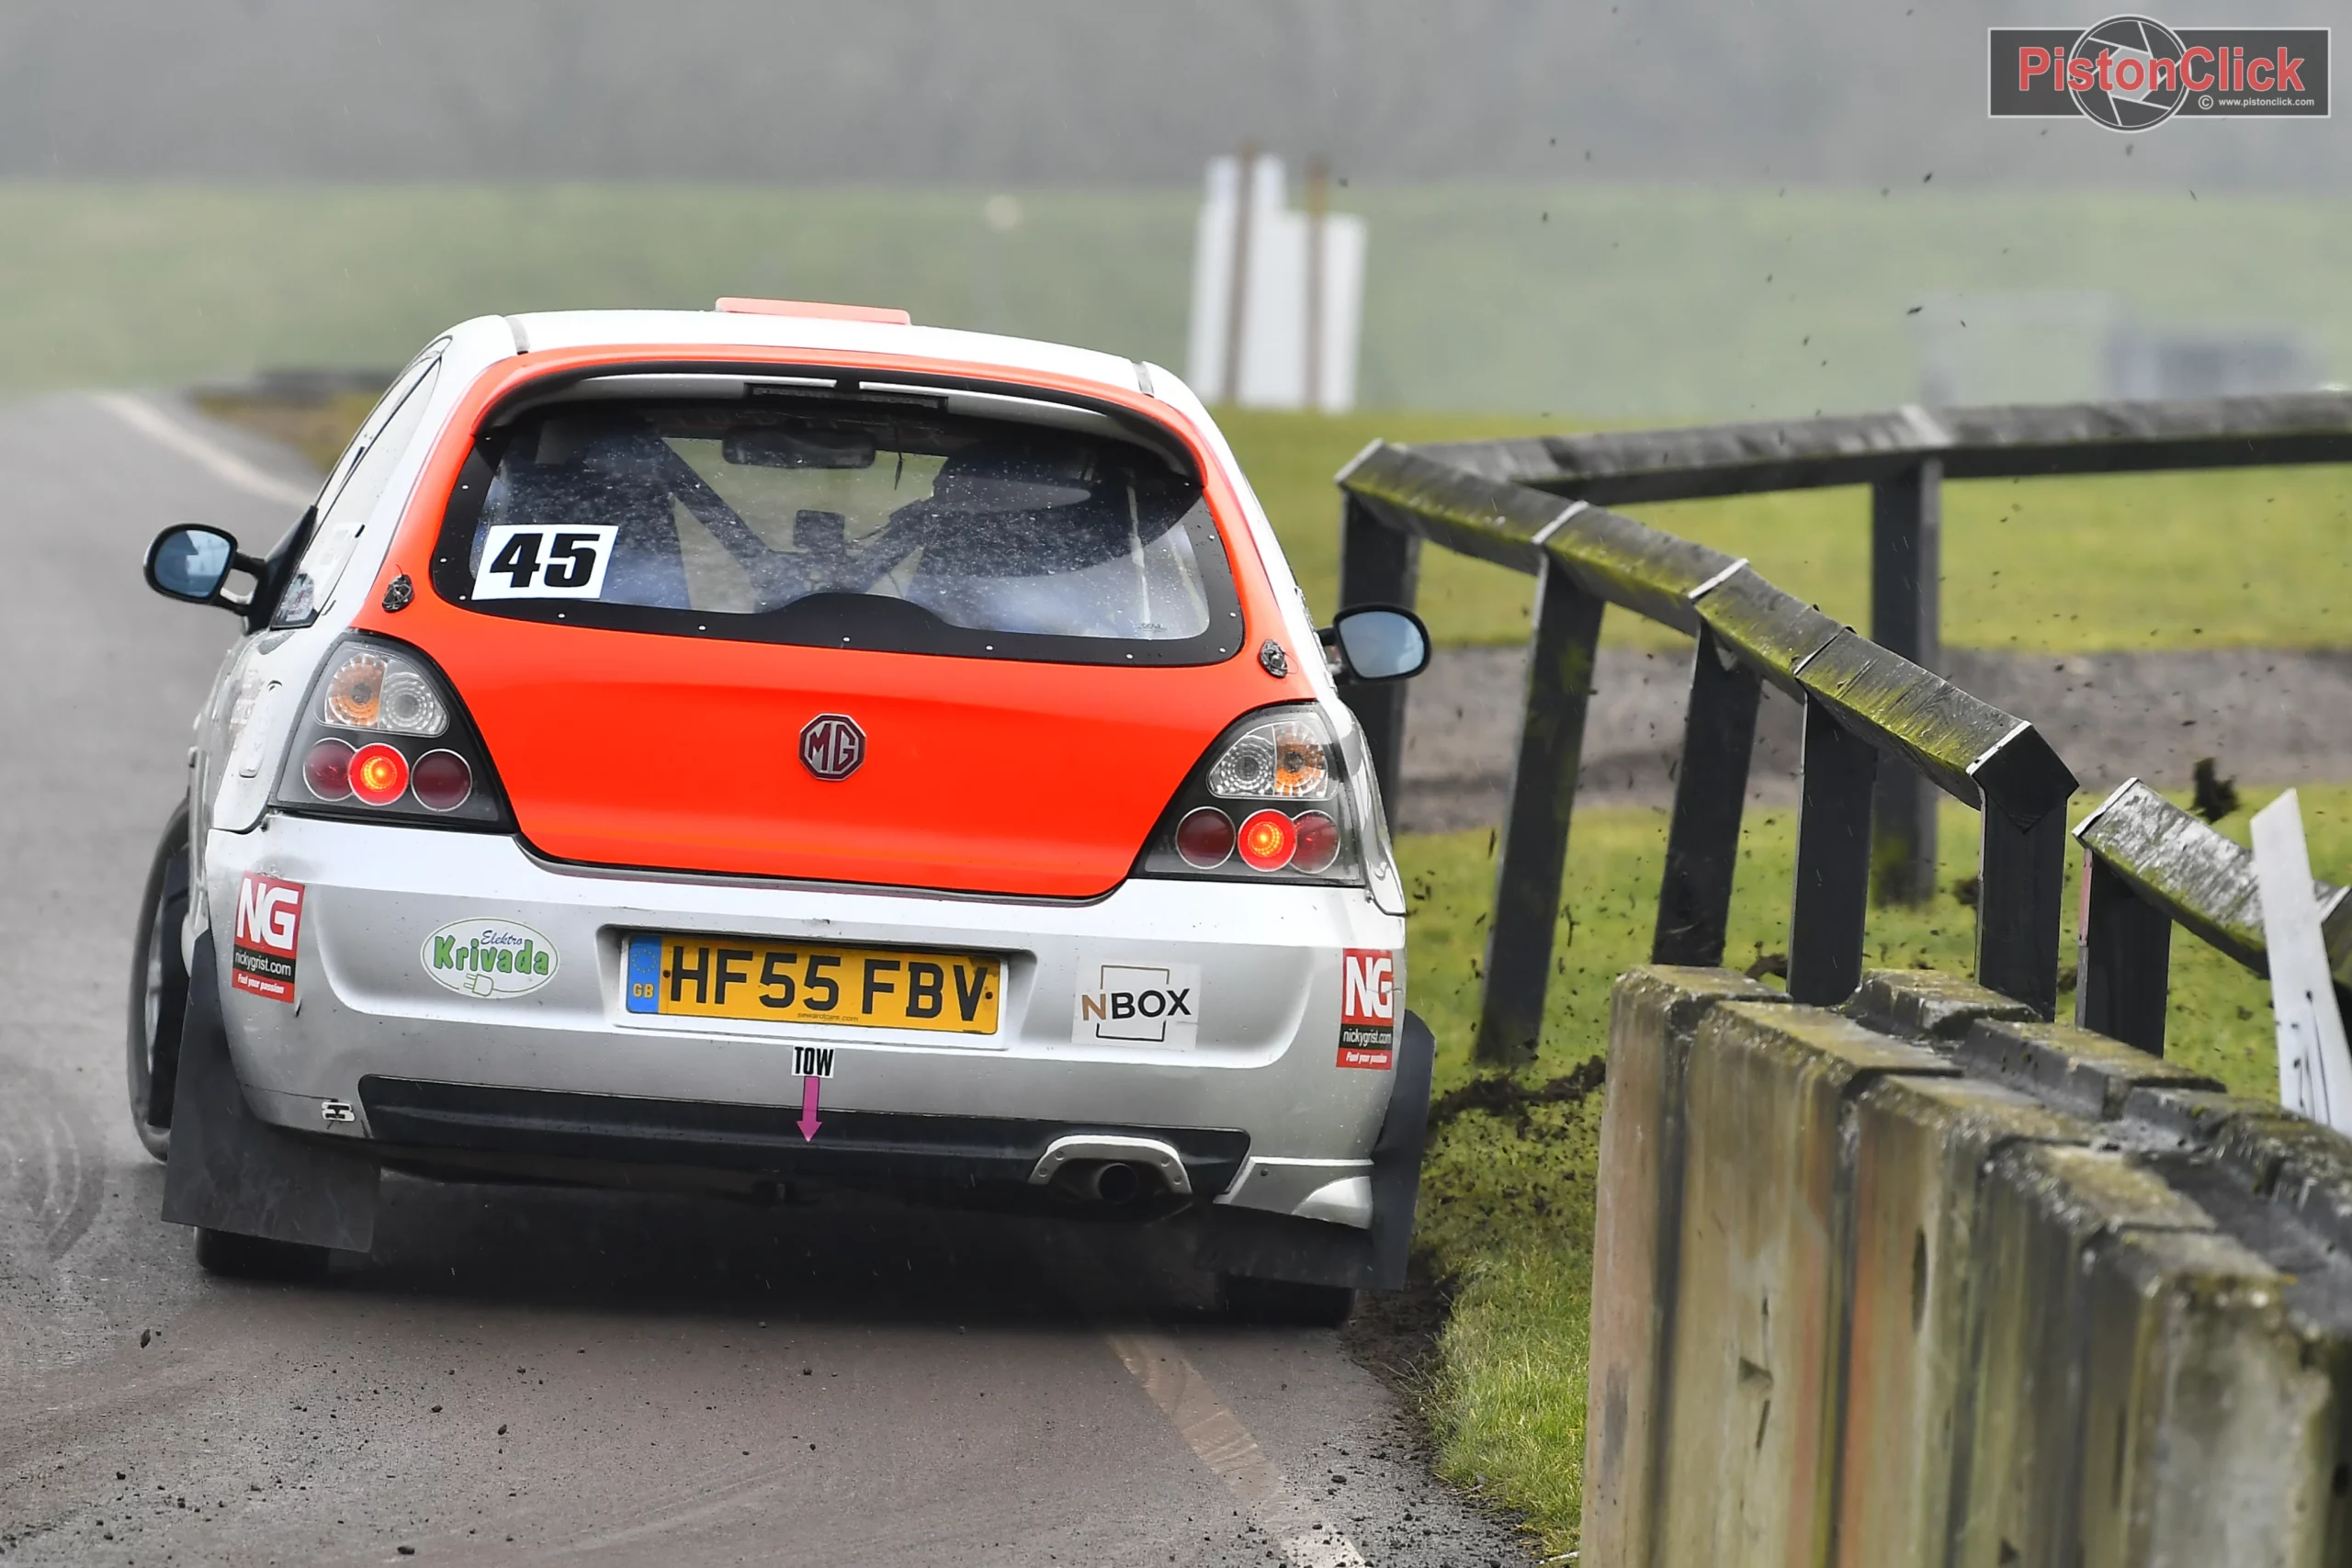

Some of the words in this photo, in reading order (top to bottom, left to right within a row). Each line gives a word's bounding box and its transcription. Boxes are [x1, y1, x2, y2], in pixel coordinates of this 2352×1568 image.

[489, 533, 601, 589] 45
[808, 723, 856, 772] MG
[236, 877, 300, 951] NG
[433, 934, 549, 976] Krivada
[481, 930, 523, 946] Elektro
[234, 950, 292, 977] nickygrist.com
[632, 983, 655, 999] GB
[669, 945, 841, 1011] HF55
[861, 958, 989, 1022] FBV
[1344, 955, 1393, 1019] NG
[1081, 987, 1193, 1021] NBOX
[1342, 1027, 1392, 1047] nickygrist.com
[794, 1046, 834, 1077] TOW
